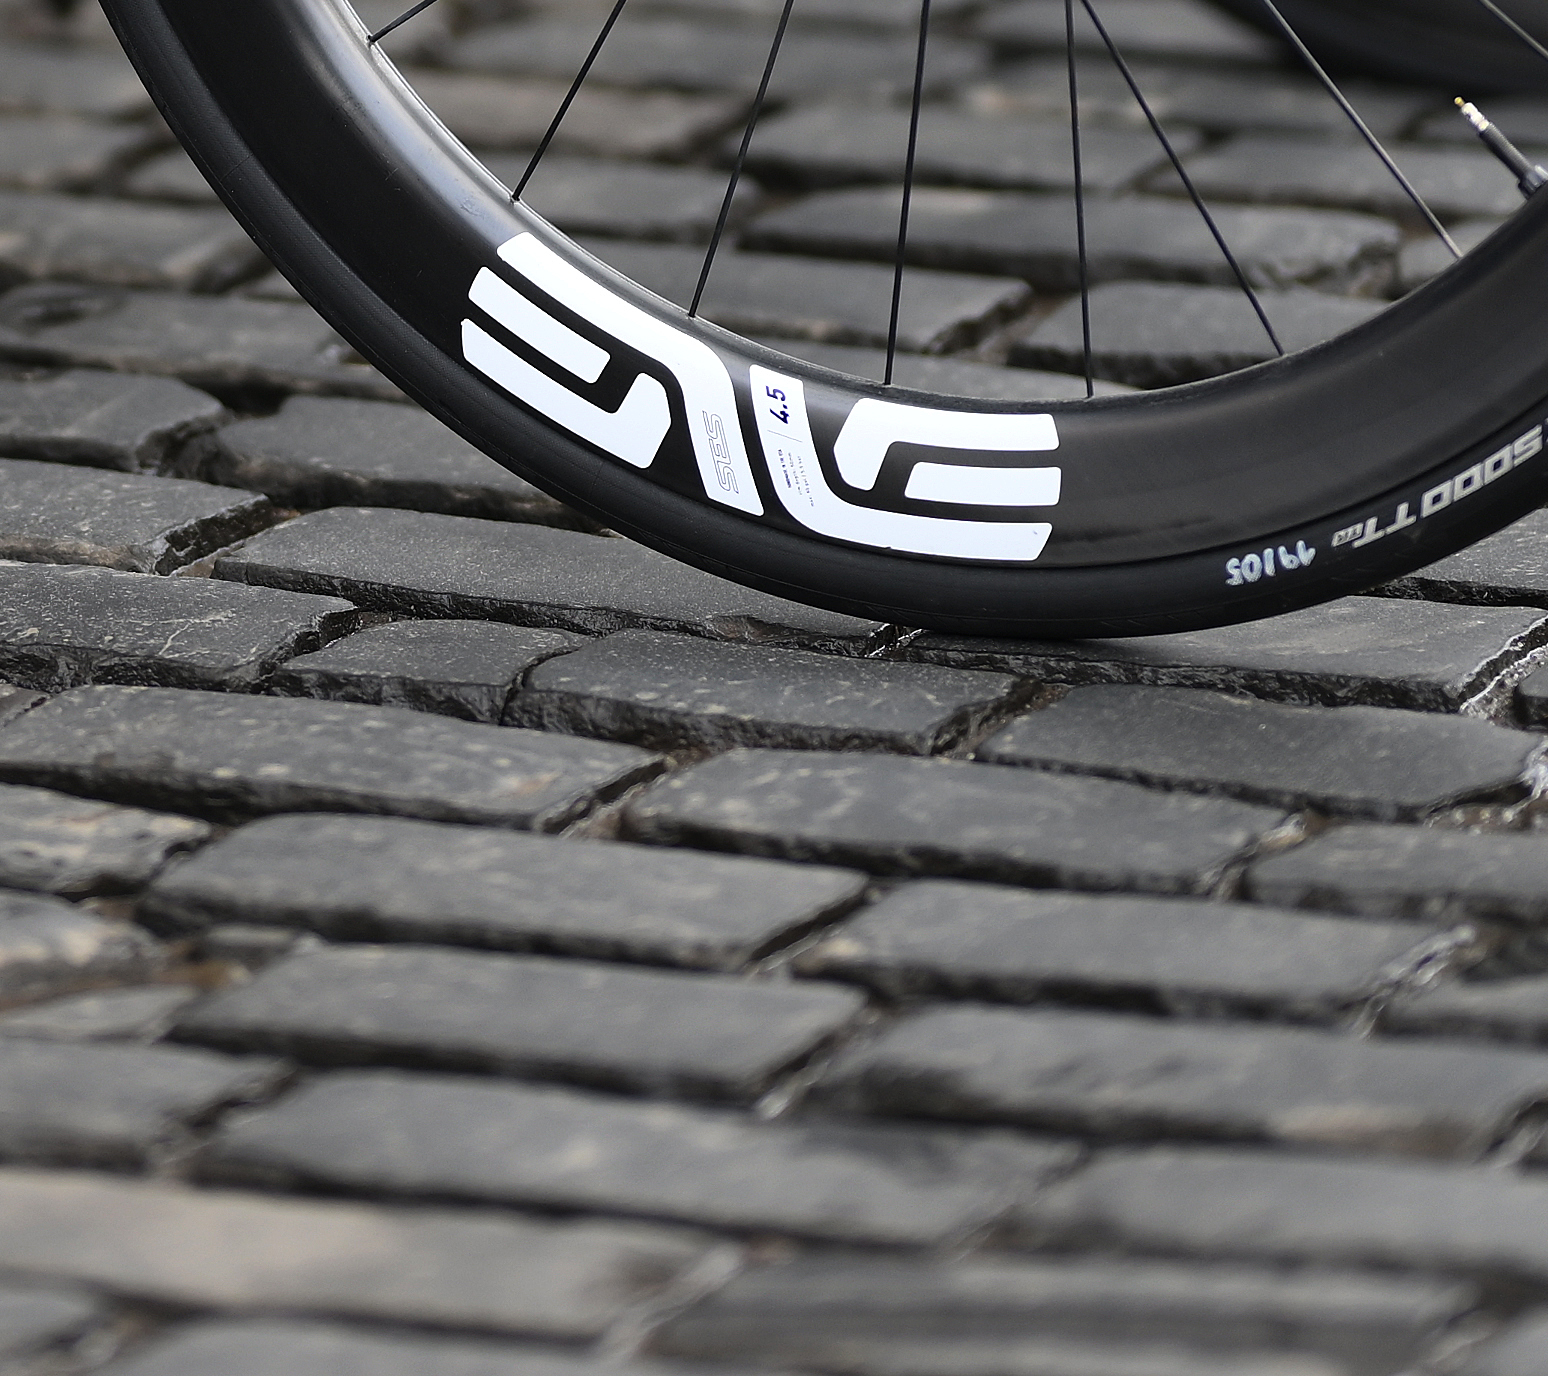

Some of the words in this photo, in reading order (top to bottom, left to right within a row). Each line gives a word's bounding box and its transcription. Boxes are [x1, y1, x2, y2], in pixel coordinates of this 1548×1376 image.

[461, 232, 1061, 561] ENVE
[766, 385, 790, 424] 4.5
[702, 409, 739, 494] SES
[1420, 424, 1543, 519] 5000
